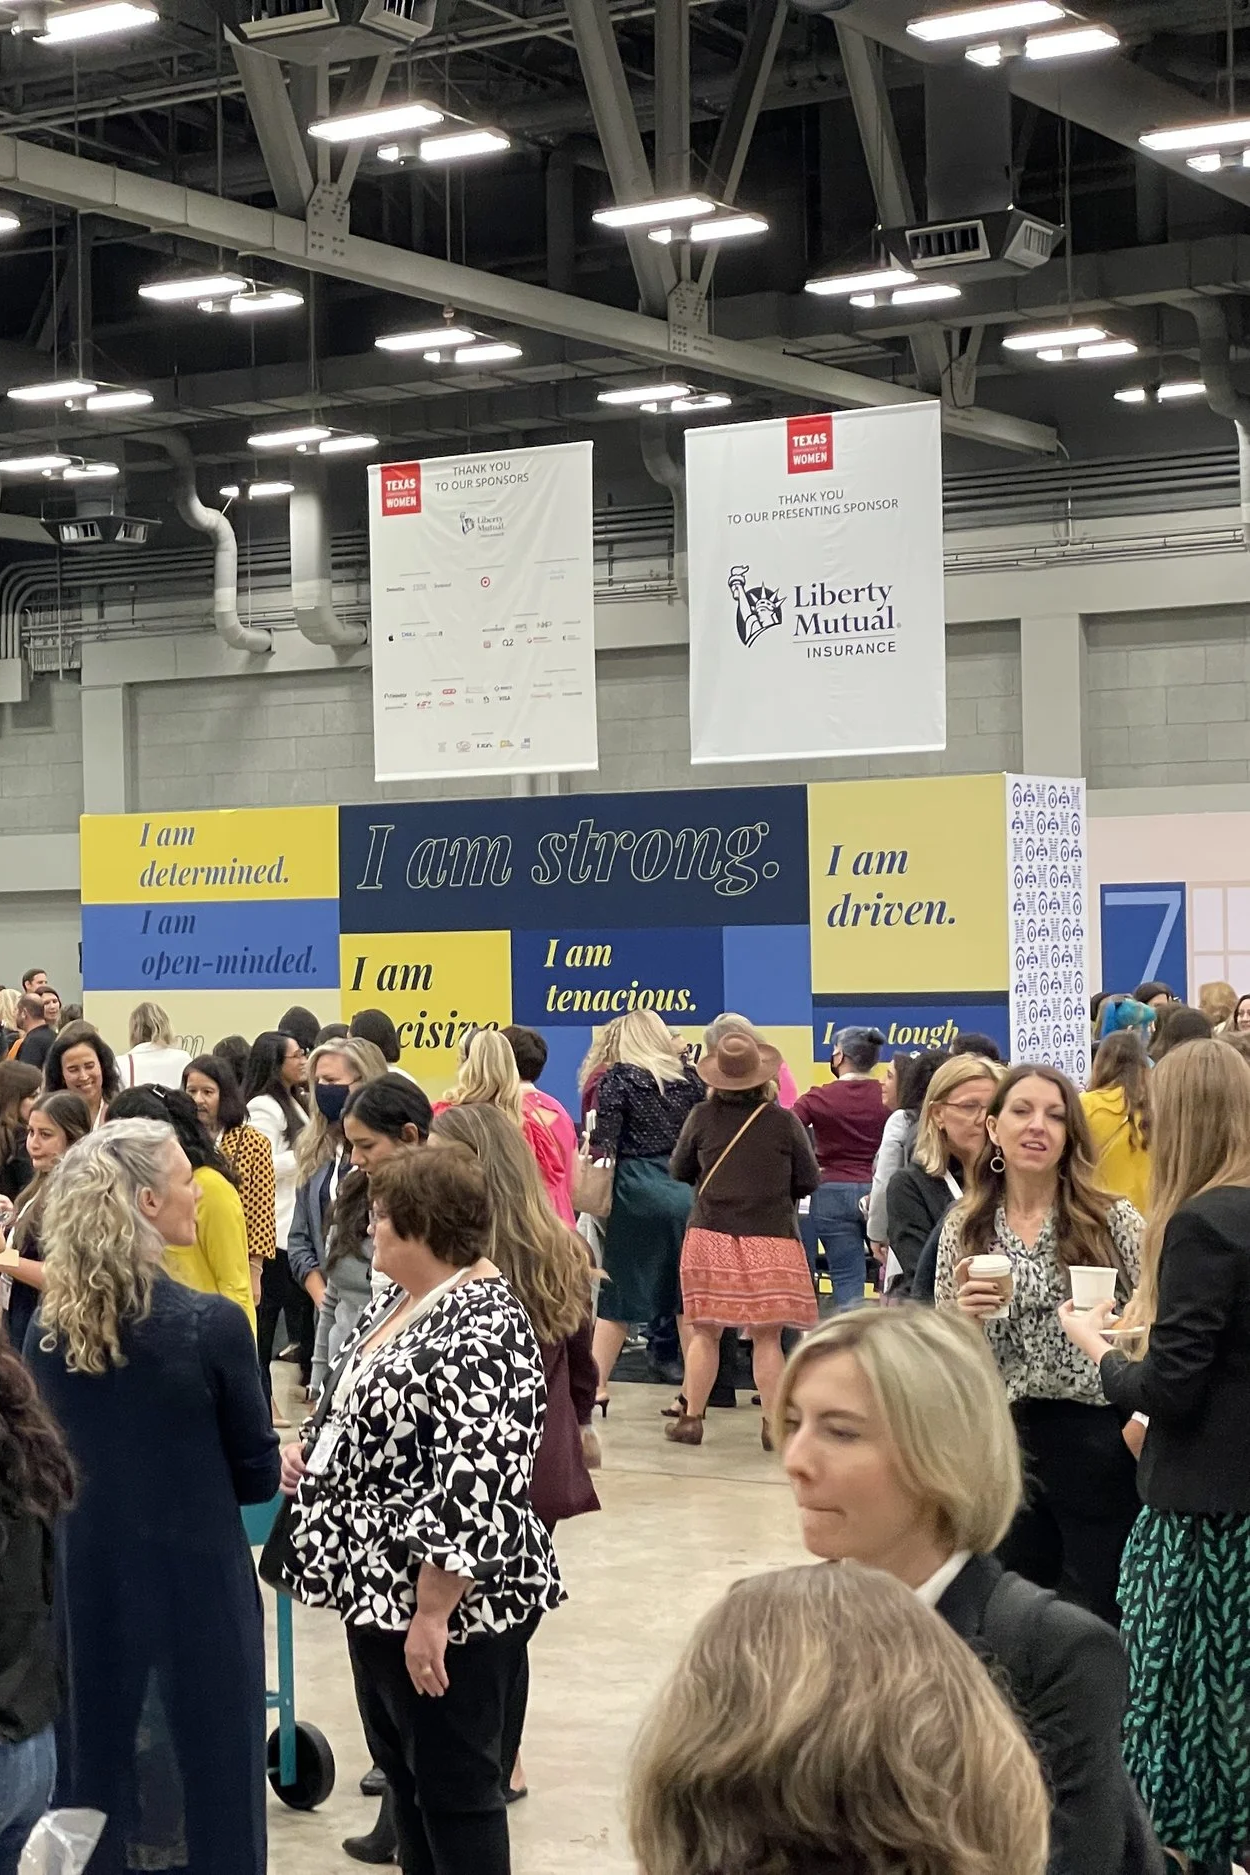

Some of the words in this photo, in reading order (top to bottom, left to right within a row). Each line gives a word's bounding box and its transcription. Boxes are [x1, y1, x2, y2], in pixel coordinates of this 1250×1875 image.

[792, 432, 827, 447] TEXAS
[453, 463, 486, 477] THANK
[490, 461, 511, 472] YOU
[793, 451, 827, 465] WOMEN
[385, 478, 416, 491] TEXAS
[435, 481, 448, 492] TO
[451, 478, 473, 490] OUR
[475, 472, 529, 488] SPONSORS
[386, 496, 417, 508] WOMEN
[778, 491, 817, 505] THANK
[820, 489, 844, 501] YOU
[728, 514, 742, 525] TO
[744, 511, 769, 523] OUR
[771, 504, 841, 521] PRESENTING
[843, 498, 899, 514] SPONSOR
[793, 582, 893, 612] Liberty
[793, 605, 895, 637] Mutual
[807, 641, 896, 658] INSURANCE
[139, 822, 151, 848] I
[156, 827, 196, 848] am
[357, 824, 395, 890] I
[406, 834, 513, 891] am
[530, 817, 781, 898] strong.
[825, 843, 844, 877] I
[851, 848, 910, 877] am
[139, 856, 290, 888] determined.
[141, 910, 152, 935] I
[157, 914, 197, 935] am
[826, 892, 958, 929] driven.
[1104, 890, 1182, 986] 7
[141, 945, 318, 981] open-minded.
[543, 939, 560, 967] I
[565, 944, 612, 967] am
[349, 956, 369, 991] I
[376, 964, 433, 991] am
[546, 980, 697, 1012] tenacious.
[822, 1022, 836, 1045] I
